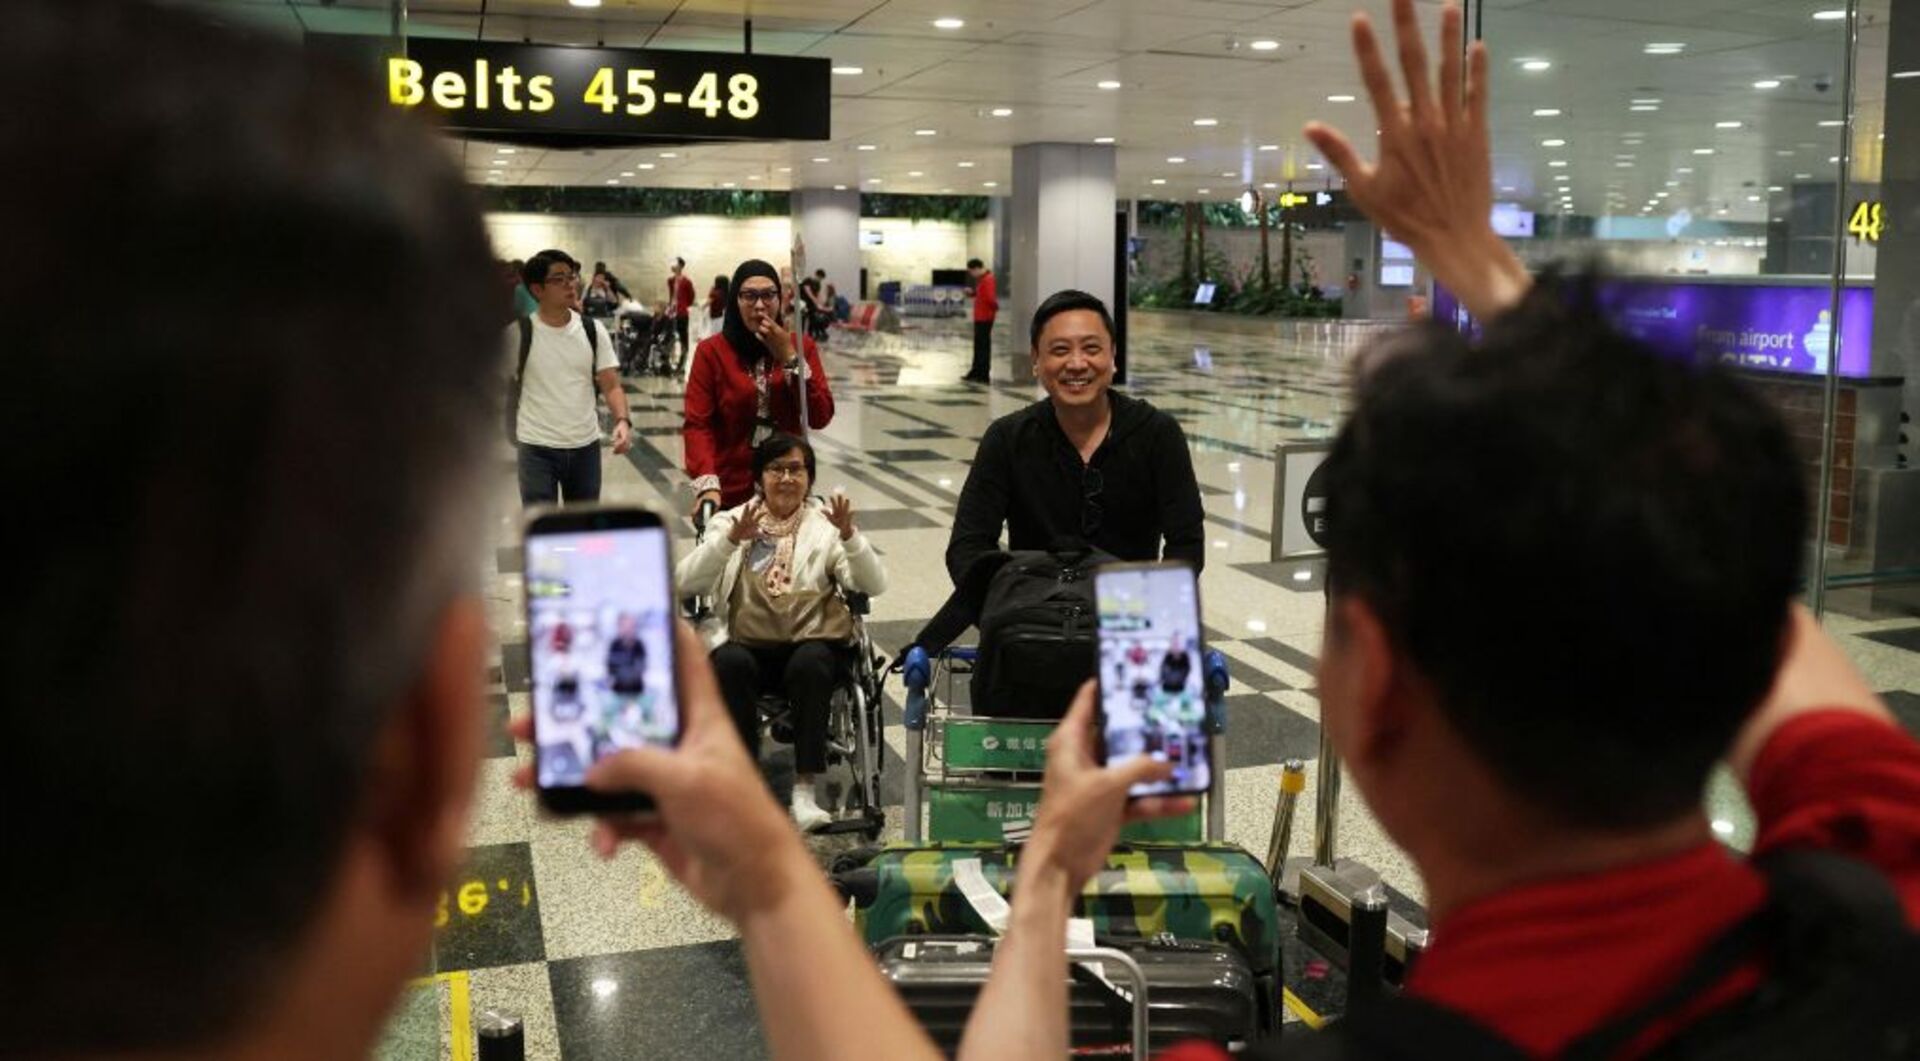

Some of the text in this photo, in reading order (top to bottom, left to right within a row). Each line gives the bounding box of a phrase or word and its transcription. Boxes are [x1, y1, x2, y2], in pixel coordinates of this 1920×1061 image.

[388, 58, 760, 119] Belts 45-48
[1739, 328, 1794, 350] airport
